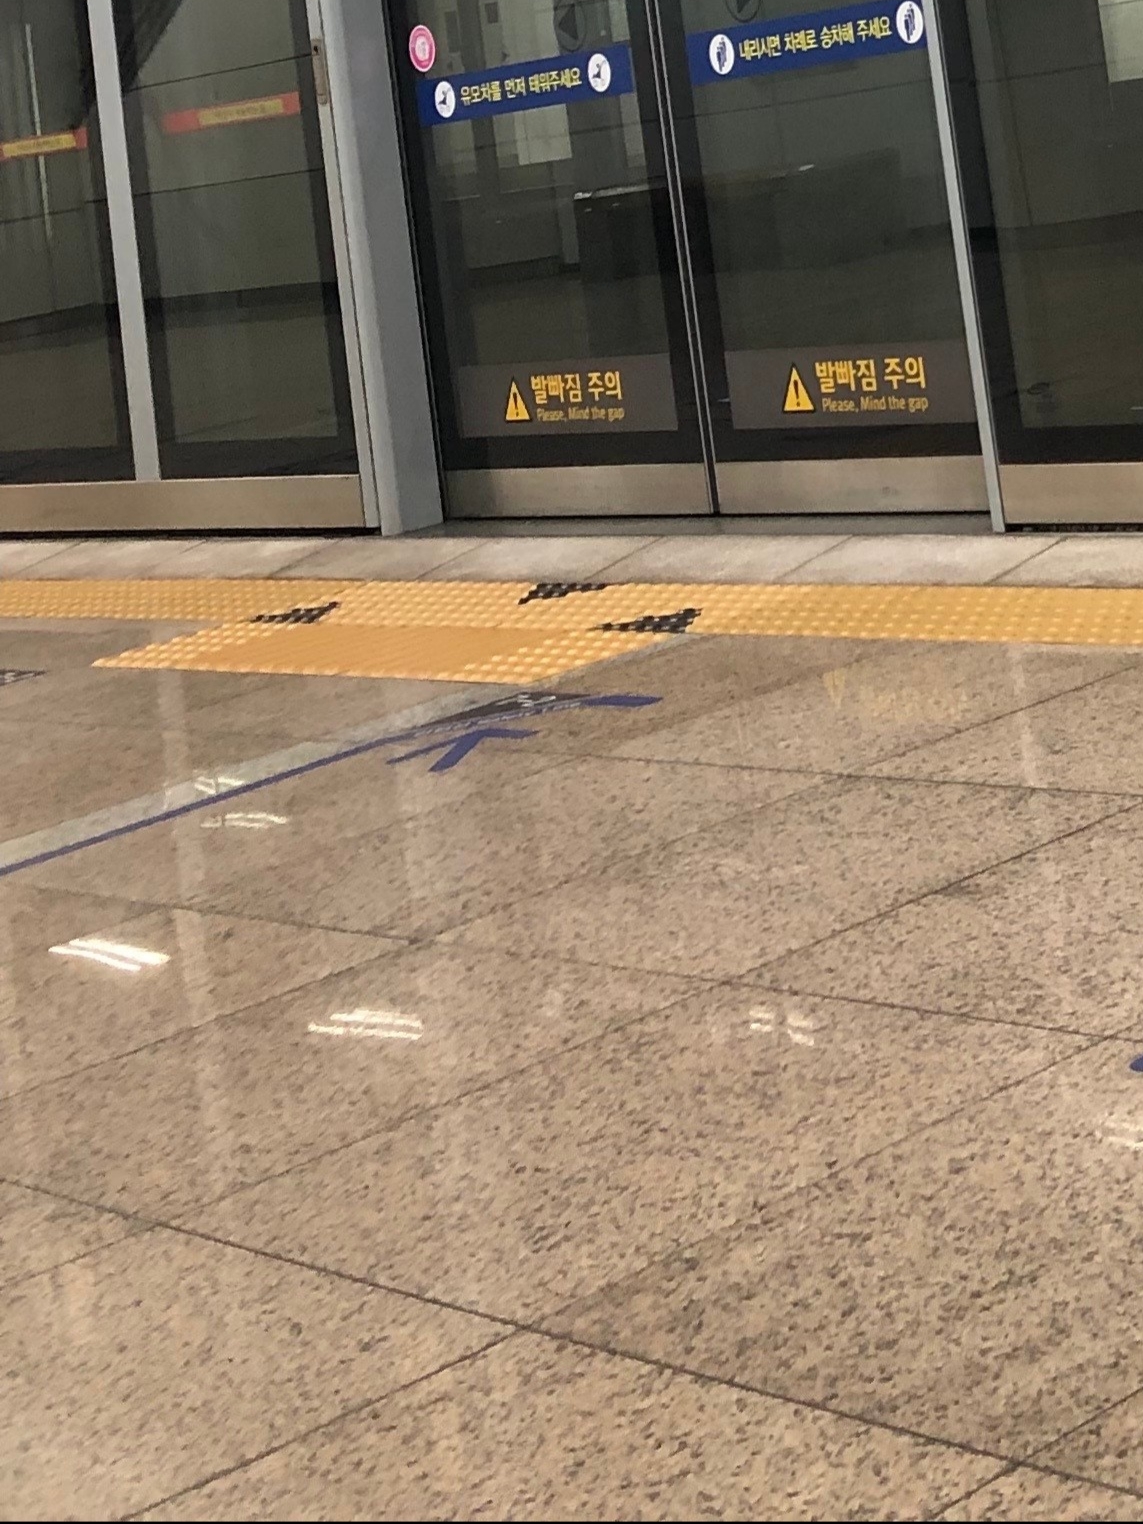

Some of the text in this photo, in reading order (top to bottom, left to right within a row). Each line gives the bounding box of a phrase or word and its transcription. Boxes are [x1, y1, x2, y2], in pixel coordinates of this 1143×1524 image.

[738, 16, 893, 61] 내리시면 차례로 승차해 주세요
[460, 67, 583, 106] 유모차를 먼저 태워주세요
[530, 370, 623, 405] 발빠짐 주의
[814, 356, 927, 394] 발빠짐 주의
[536, 405, 625, 423] Please, Mind the gap
[821, 395, 929, 414] Please, Mind the gap
